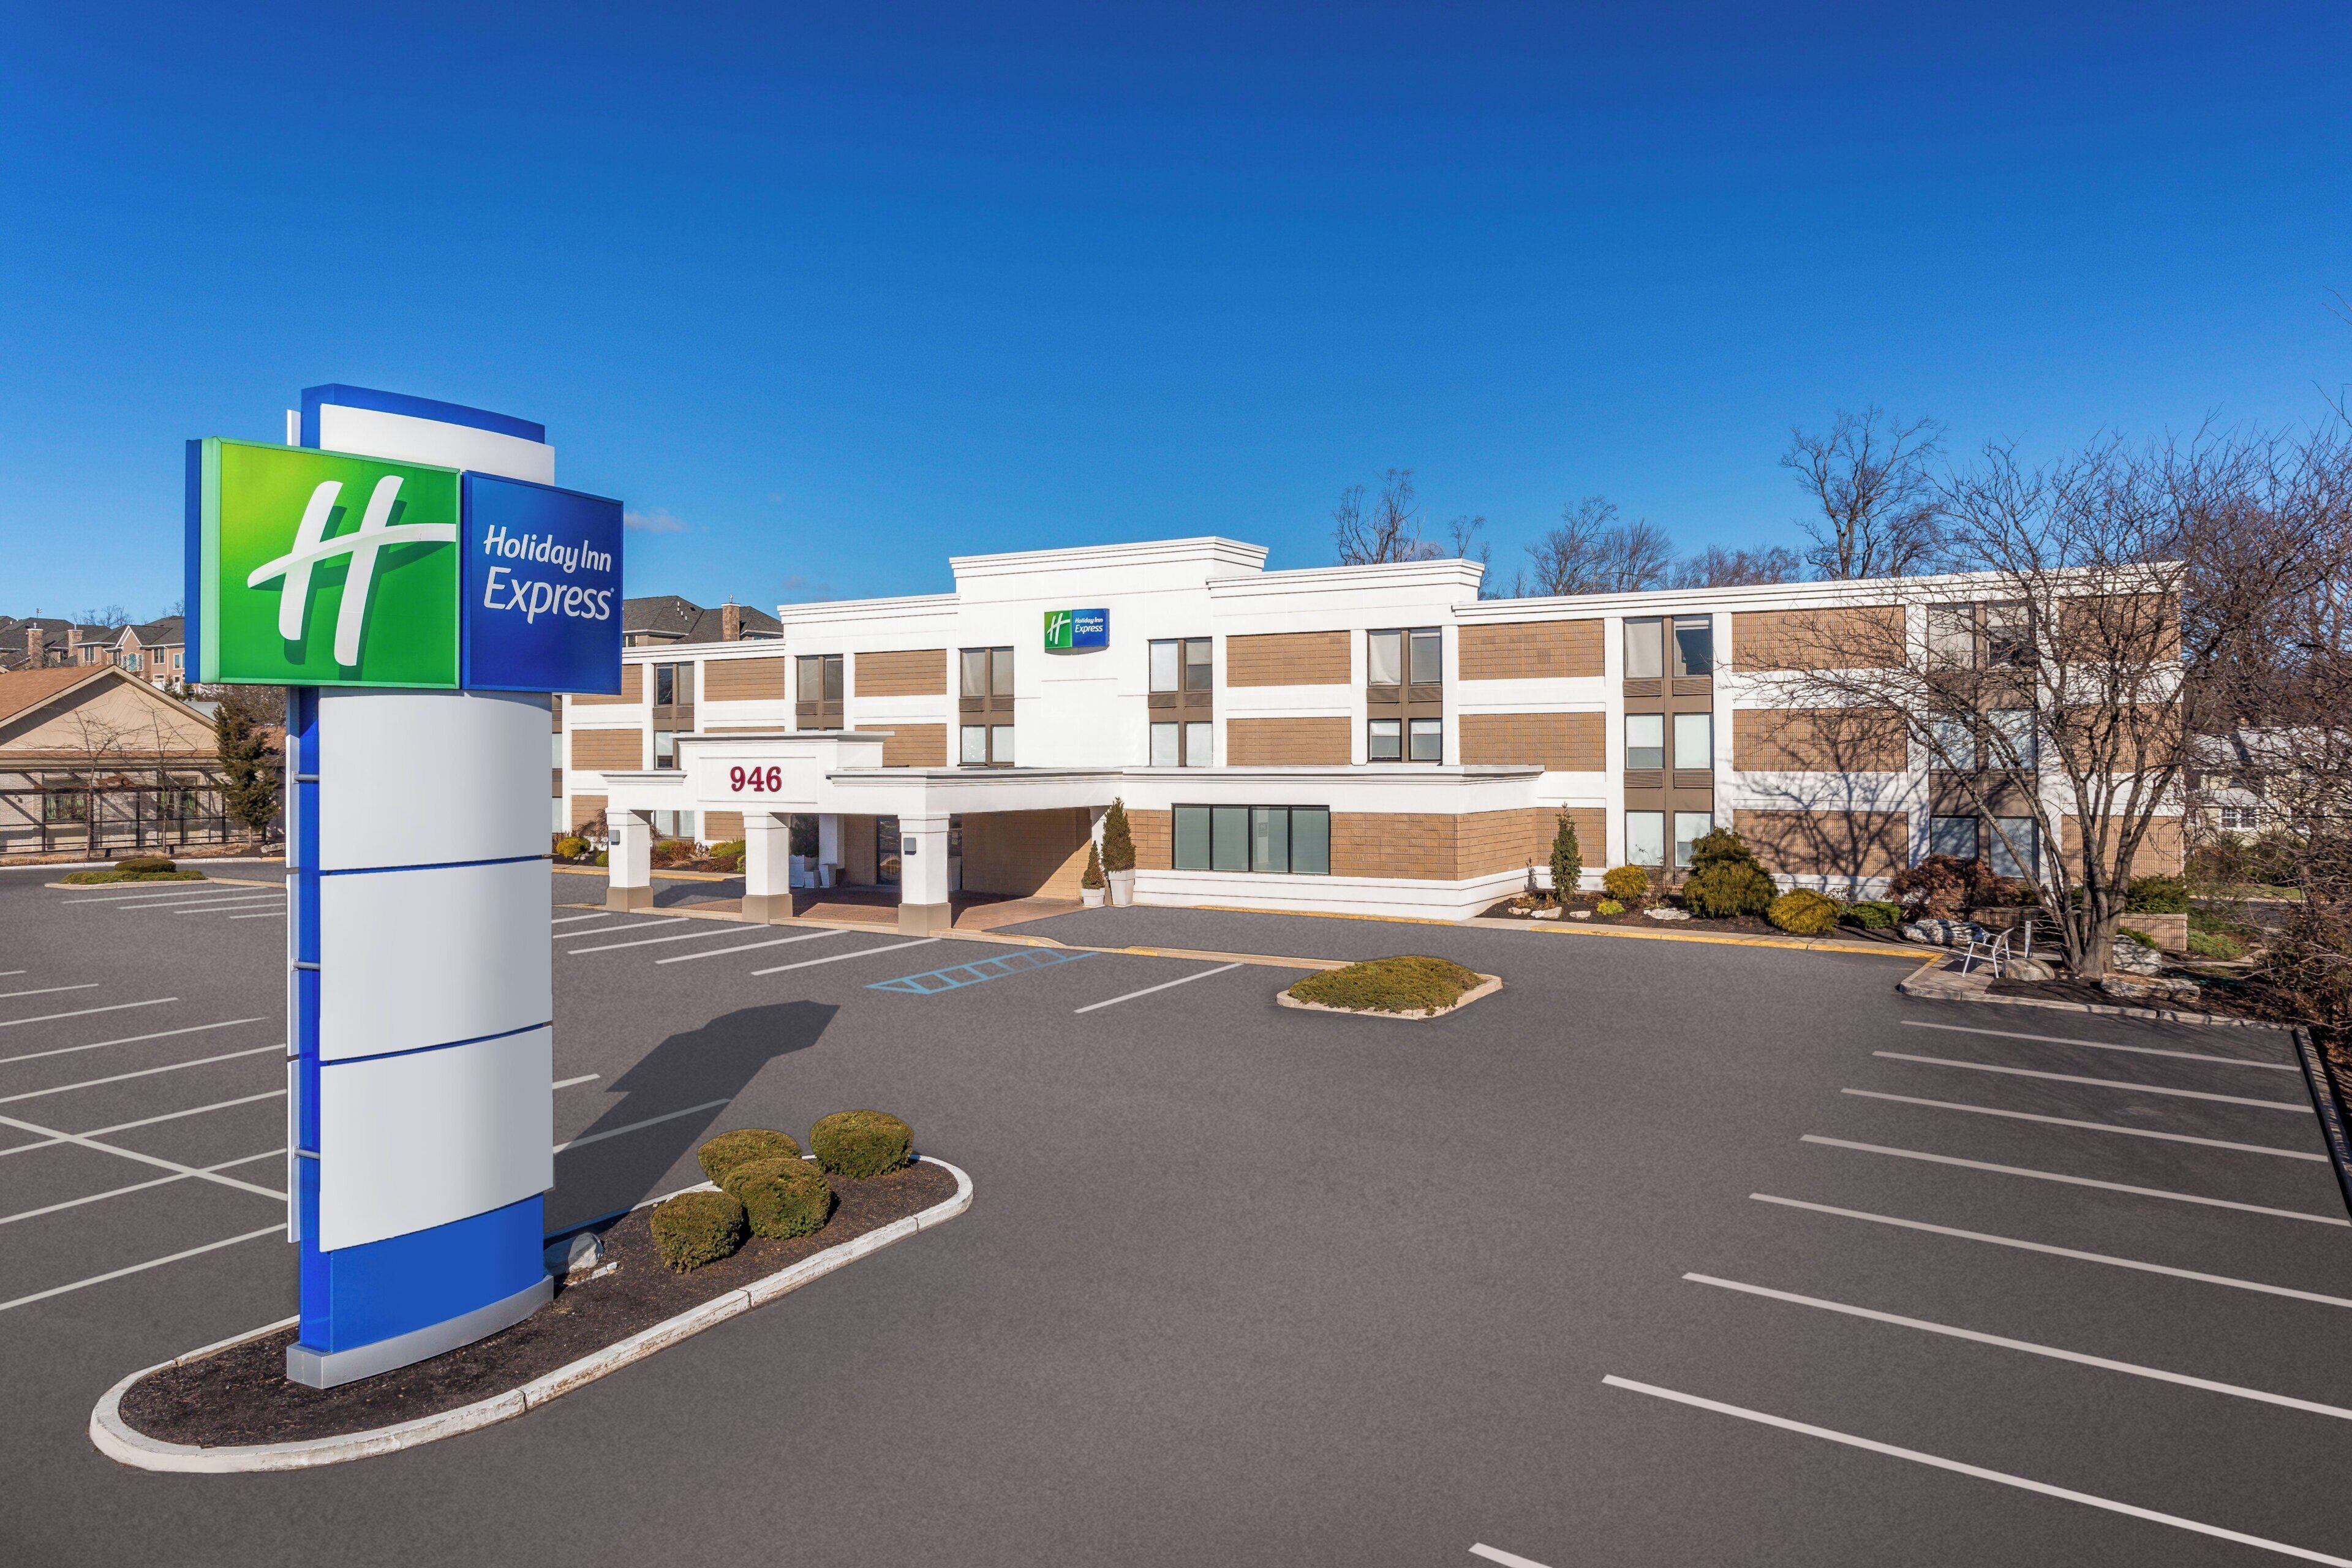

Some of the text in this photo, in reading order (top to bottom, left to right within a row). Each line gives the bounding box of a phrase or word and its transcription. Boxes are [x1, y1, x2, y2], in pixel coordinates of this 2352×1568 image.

[483, 524, 611, 573] Holiday Inn
[484, 566, 612, 624] Express
[1075, 625, 1103, 634] Express
[730, 766, 782, 793] 946
